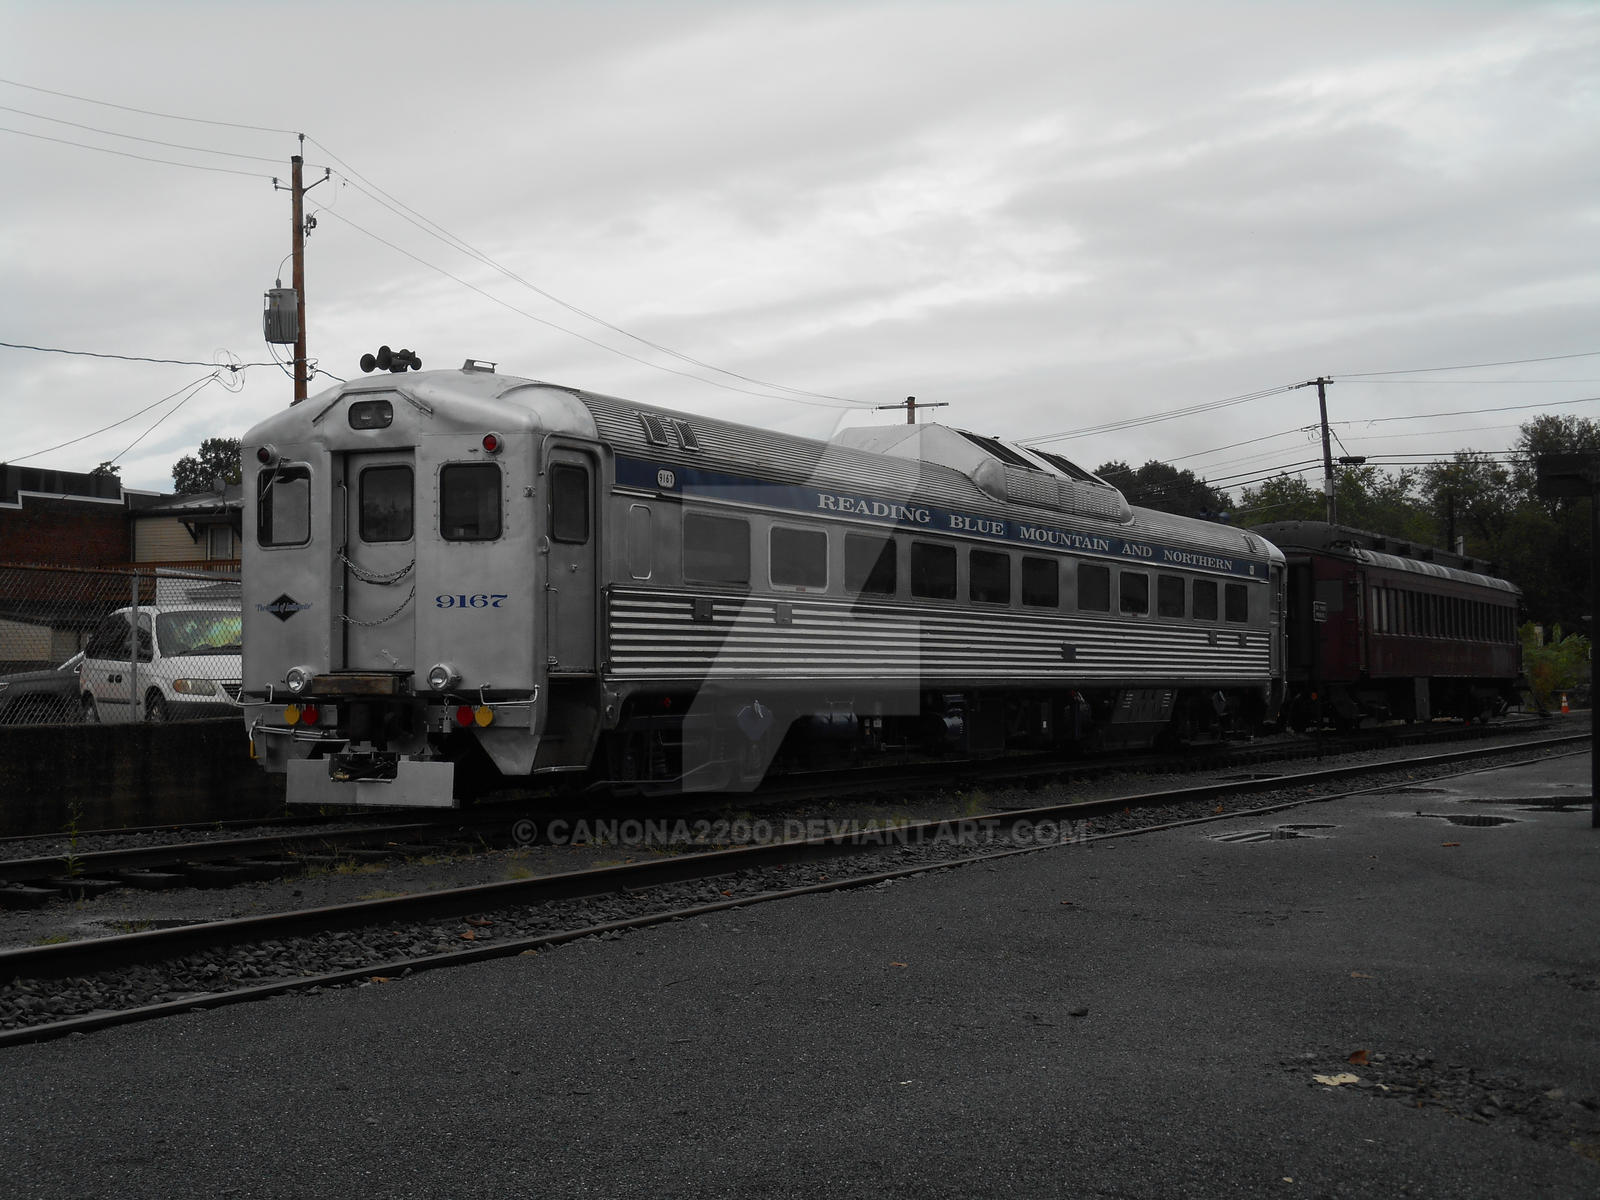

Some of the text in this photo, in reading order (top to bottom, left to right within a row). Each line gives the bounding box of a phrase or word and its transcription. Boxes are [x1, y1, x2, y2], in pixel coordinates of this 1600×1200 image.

[658, 472, 673, 484] 9167
[817, 493, 1233, 571] READING BLUE MOUNTAIN AND NORTHERN
[435, 594, 508, 608] 9167
